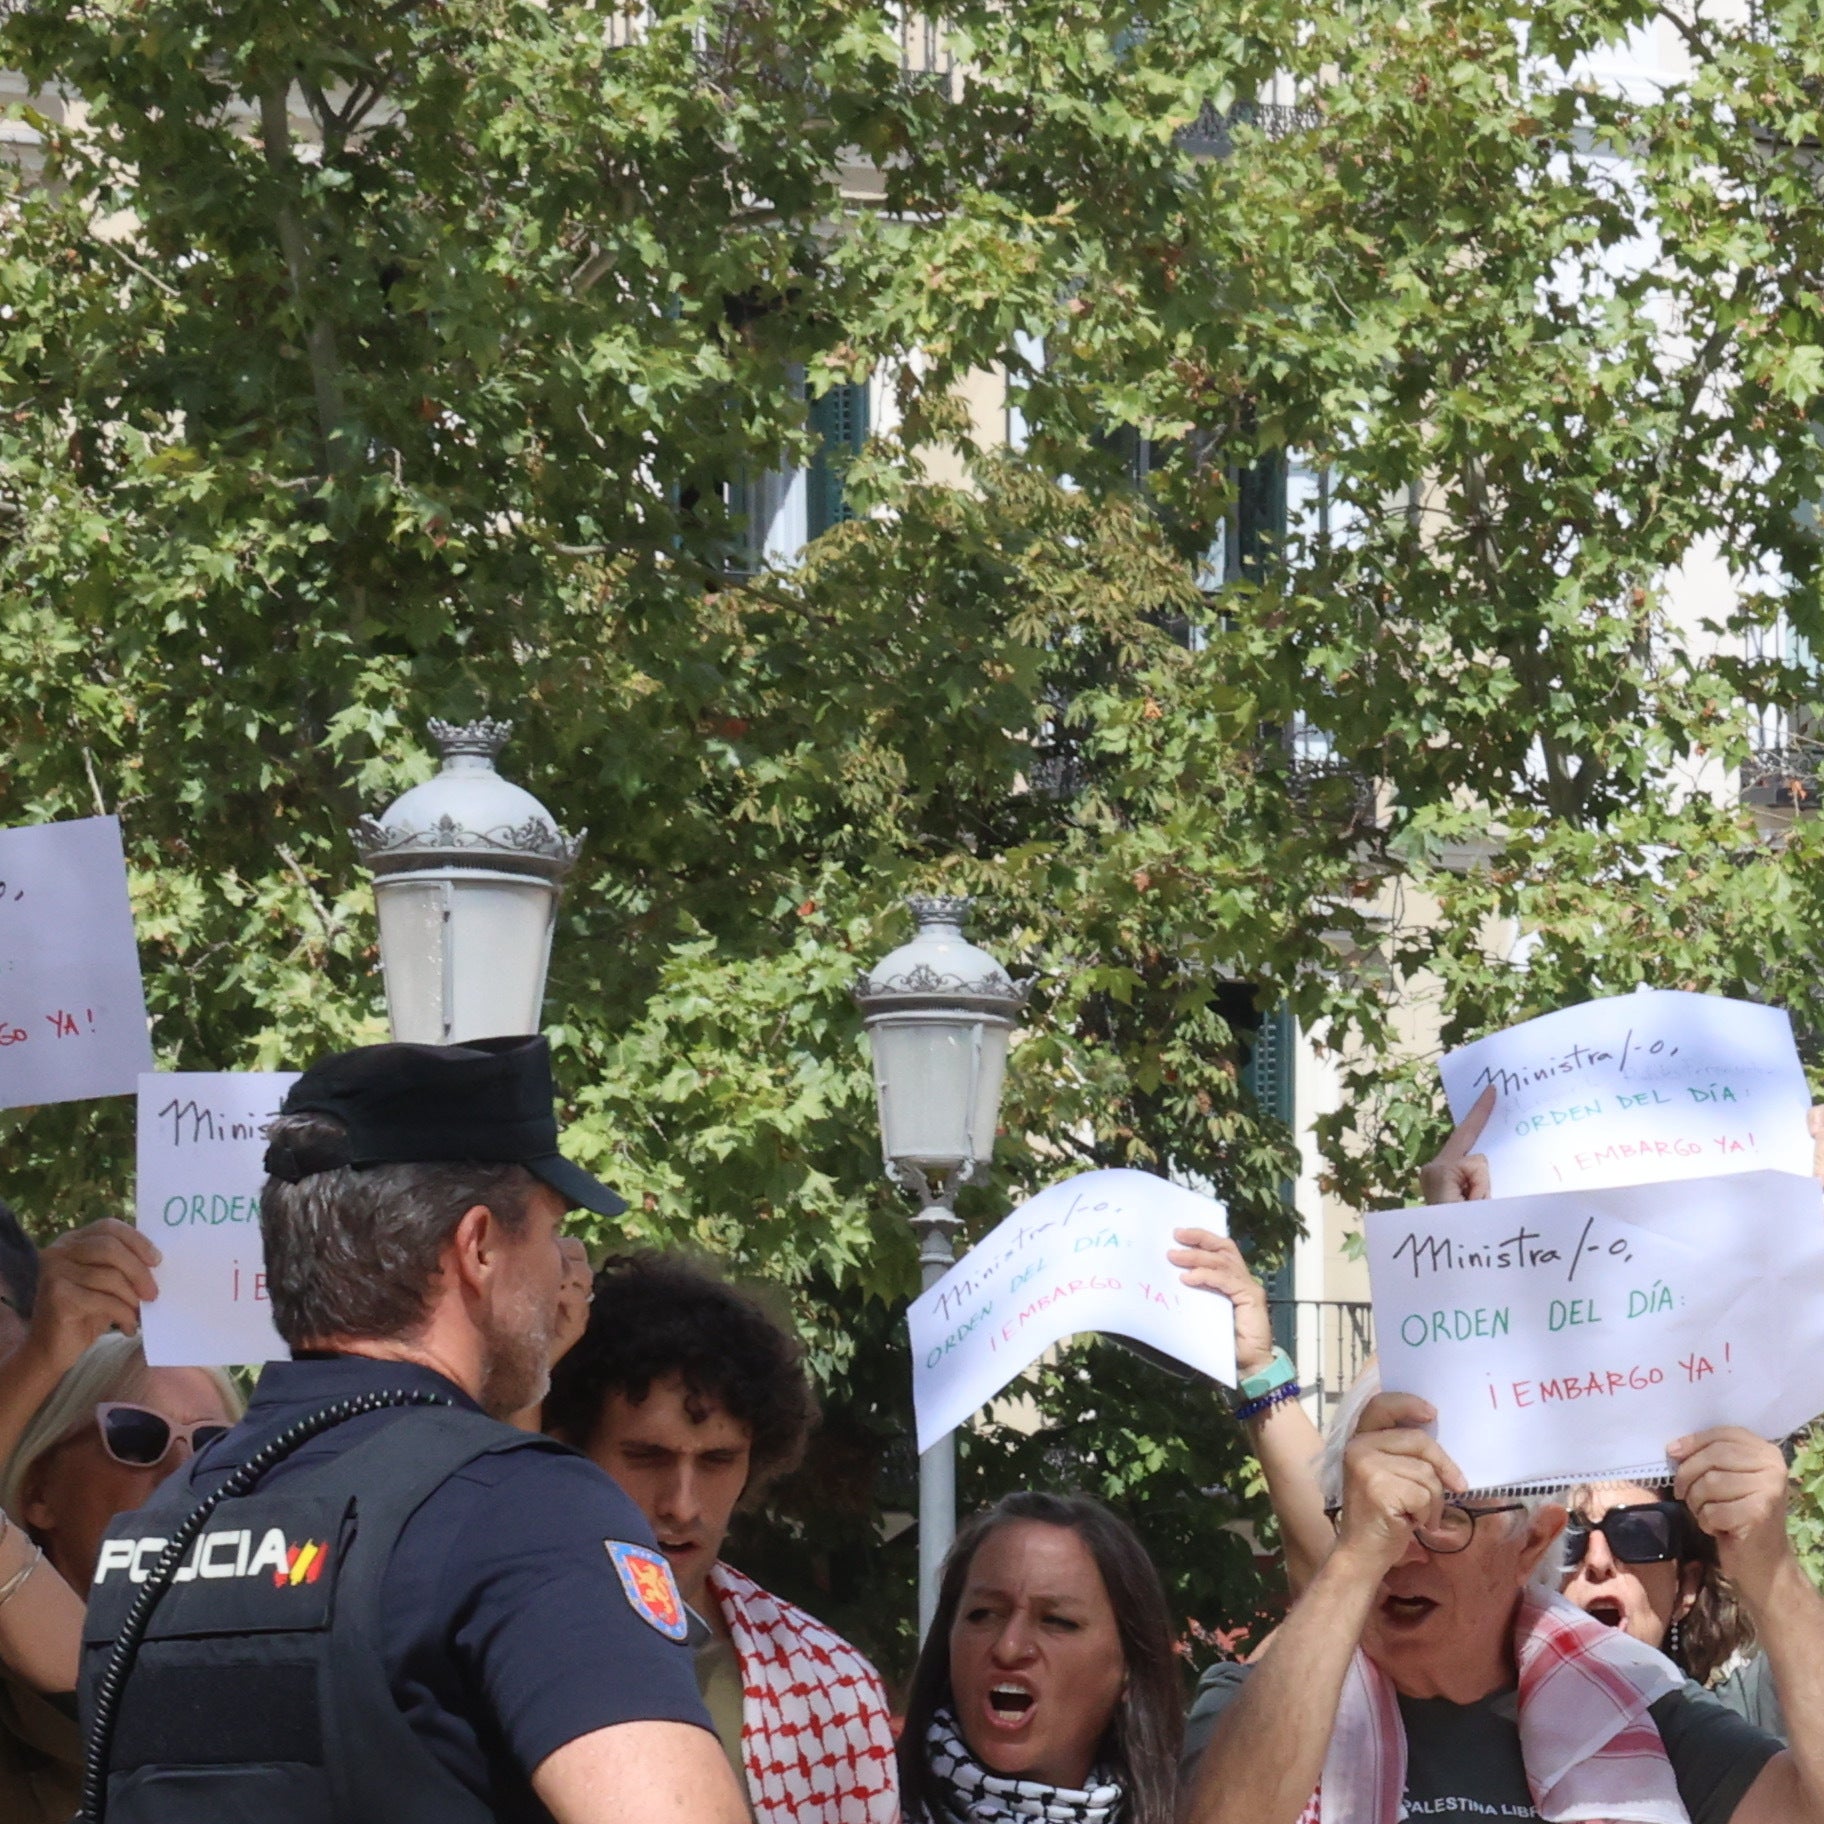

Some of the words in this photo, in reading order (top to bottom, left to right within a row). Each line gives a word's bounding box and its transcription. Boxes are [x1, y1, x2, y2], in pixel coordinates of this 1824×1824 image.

[46, 1008, 97, 1039] YA!
[1515, 1099, 1602, 1137] ORDEN
[1615, 1089, 1672, 1108] DEL
[1713, 1132, 1760, 1154] YA!
[926, 1300, 993, 1370] ORDEN
[1010, 1257, 1046, 1294] DEL
[1138, 1281, 1181, 1311] YA!
[1401, 1307, 1511, 1347] ORDEN
[1549, 1299, 1602, 1331] DEL
[1678, 1341, 1733, 1382] YA!
